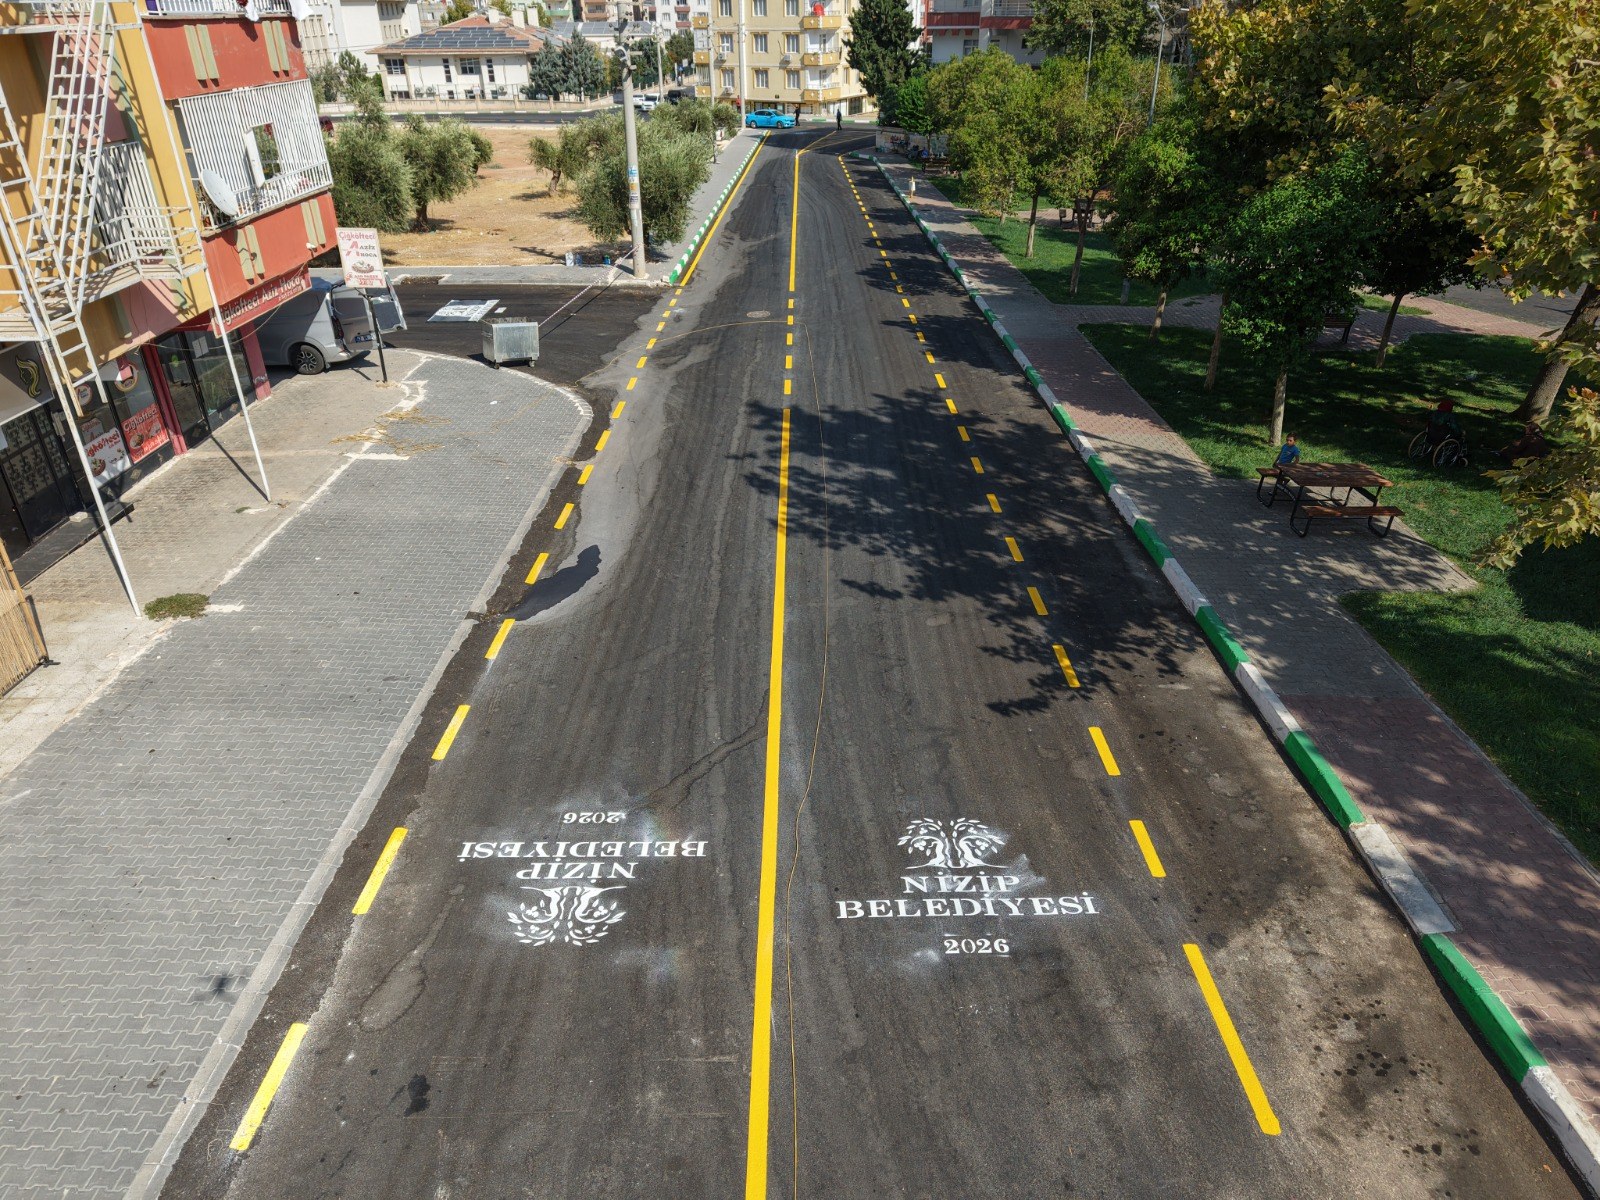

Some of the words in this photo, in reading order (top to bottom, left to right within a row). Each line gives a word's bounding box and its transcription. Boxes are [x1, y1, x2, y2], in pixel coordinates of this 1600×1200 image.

[563, 811, 626, 824] 2026
[457, 841, 709, 862] BELEDİYESİ
[899, 871, 1020, 893] NİZİP
[835, 892, 1100, 919] BELEDİYESİ
[943, 938, 1010, 954] 2026
